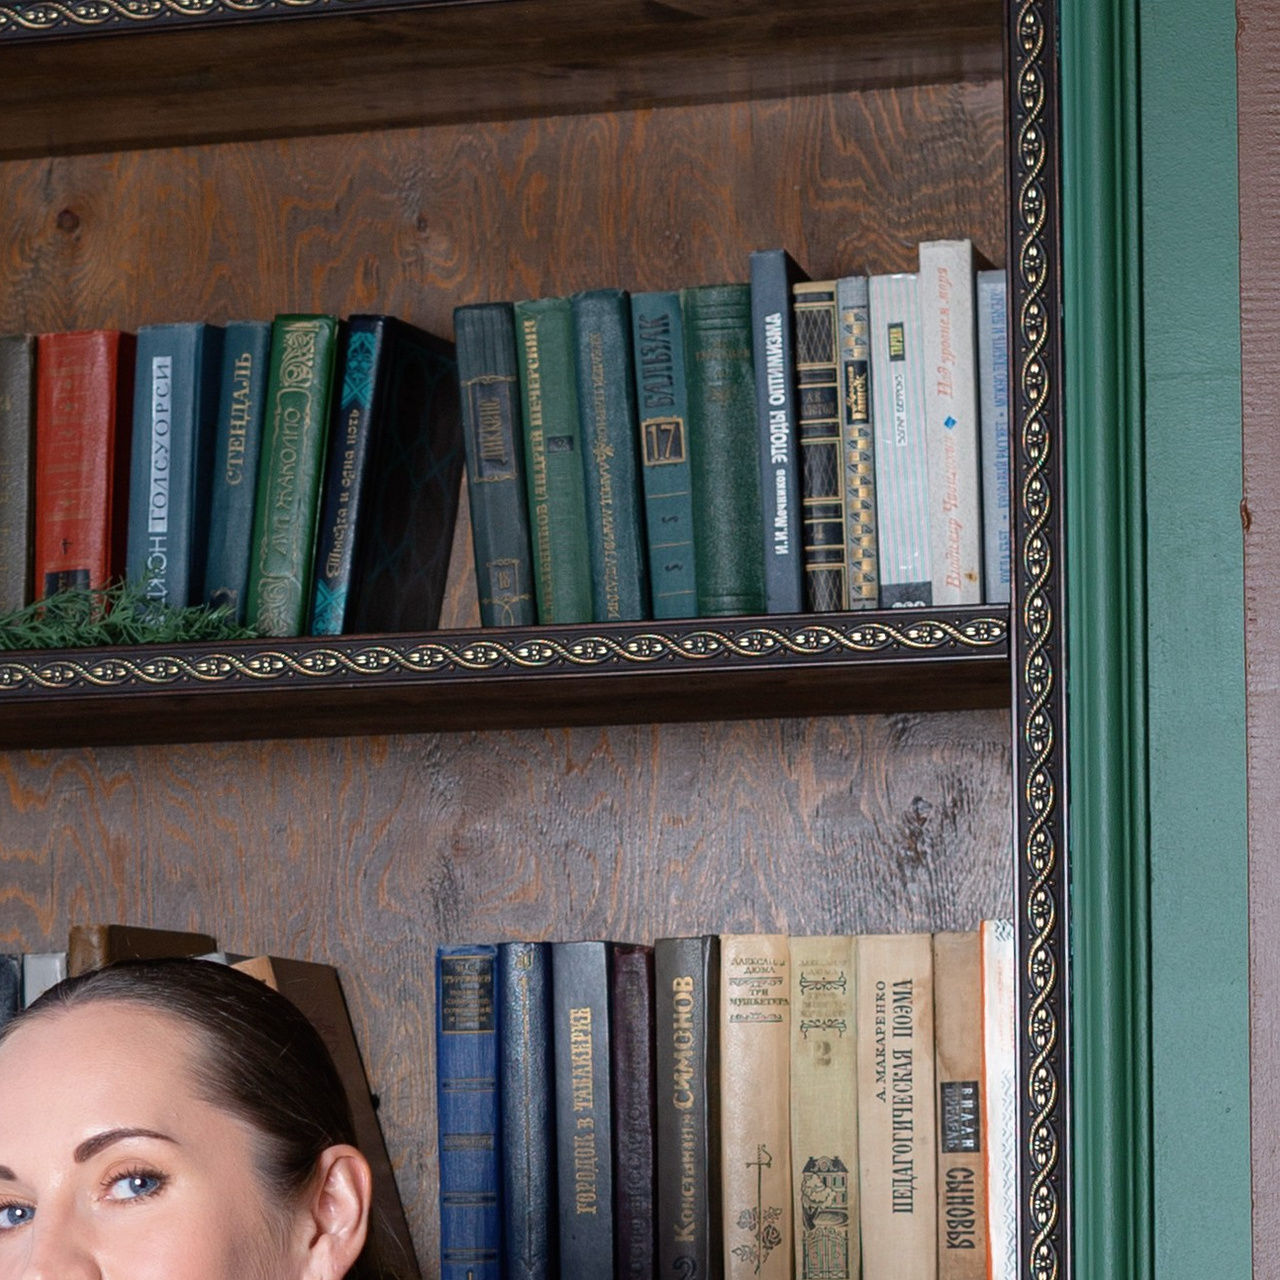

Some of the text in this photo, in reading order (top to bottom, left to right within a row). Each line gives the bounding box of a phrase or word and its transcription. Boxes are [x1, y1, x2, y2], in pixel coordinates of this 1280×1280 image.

[638, 313, 675, 408] БАЛЬЗАК
[765, 313, 786, 406] ОПТИМИЗМА
[150, 362, 169, 522] ГОЛСУОРСИ
[225, 353, 252, 485] СТЕНДАЛЬ
[647, 423, 676, 461] 17
[769, 410, 789, 464] ЭТЮДЫ
[729, 997, 790, 1007] МУШКЕТЕРА
[743, 966, 776, 975] ДЮМА
[748, 988, 769, 997] ТРИ
[570, 1007, 593, 1111] ТАБАКЕРКЕ
[672, 976, 695, 1108] СИМОНОВ
[875, 980, 887, 1104] А. МАКАРЕНКО
[891, 978, 918, 1214] ПЕДАГОГИЧЕСКАЯ ПОЭМА
[574, 1133, 597, 1214] ГОРОДОК
[946, 1167, 976, 1249] СЫНОВЬЯ
